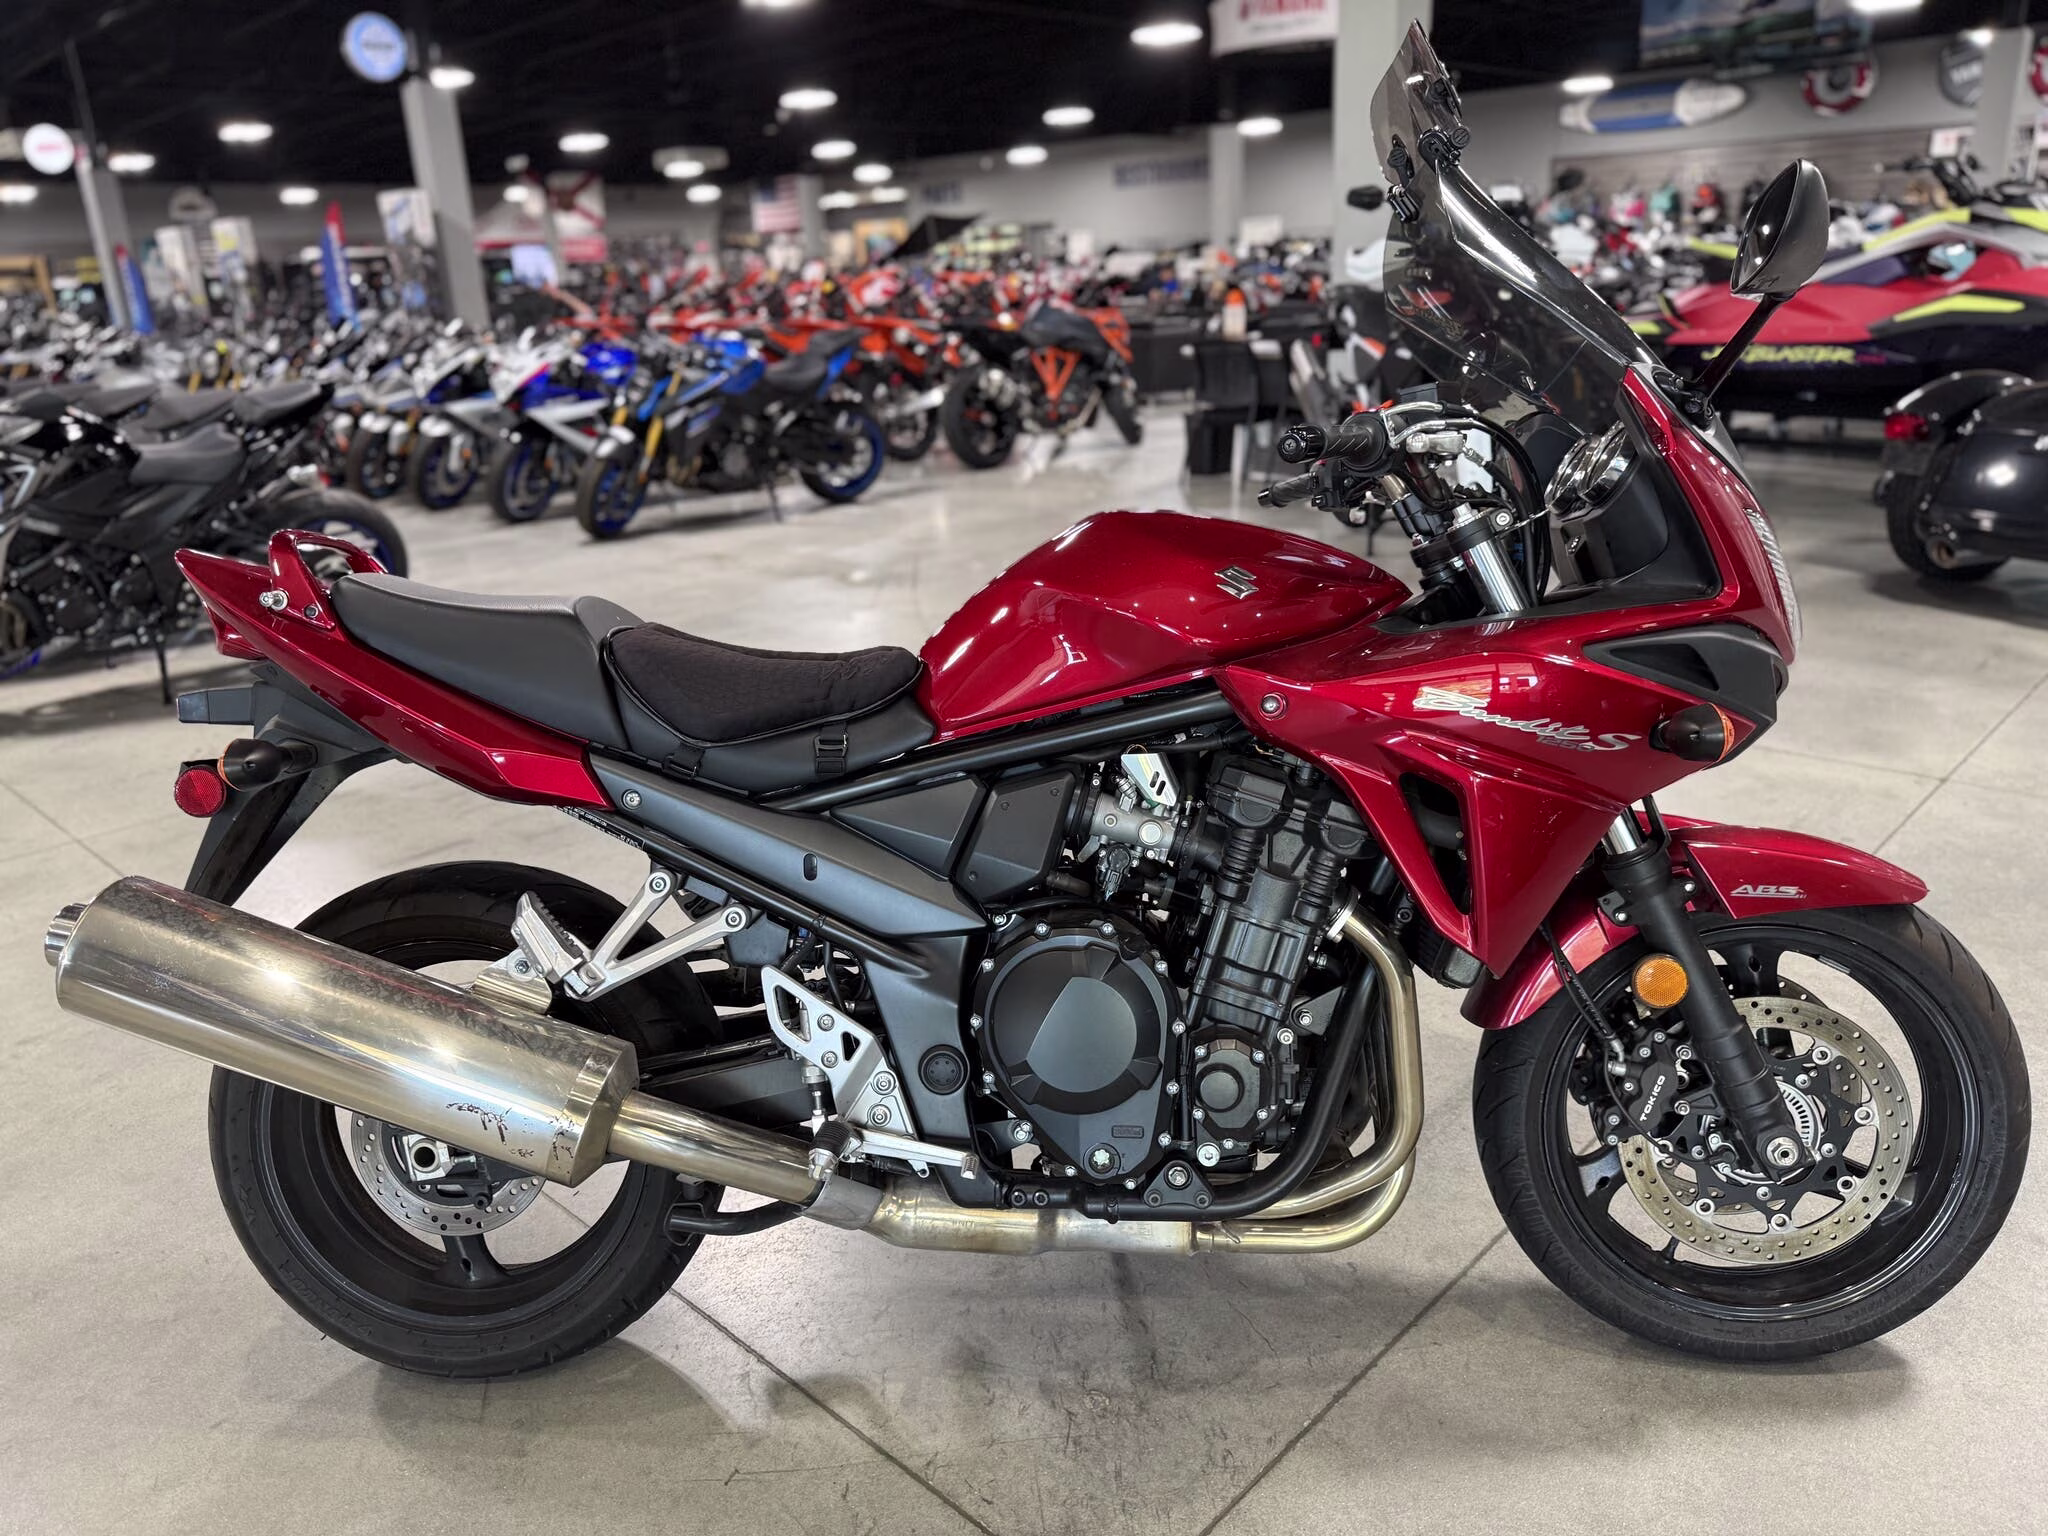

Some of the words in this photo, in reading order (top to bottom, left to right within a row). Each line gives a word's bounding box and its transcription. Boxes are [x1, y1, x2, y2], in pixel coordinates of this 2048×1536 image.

[1413, 686, 1591, 740] Bandit
[1587, 733, 1642, 751] S
[1730, 884, 1803, 897] ABS
[1640, 1075, 1666, 1121] TOKICO
